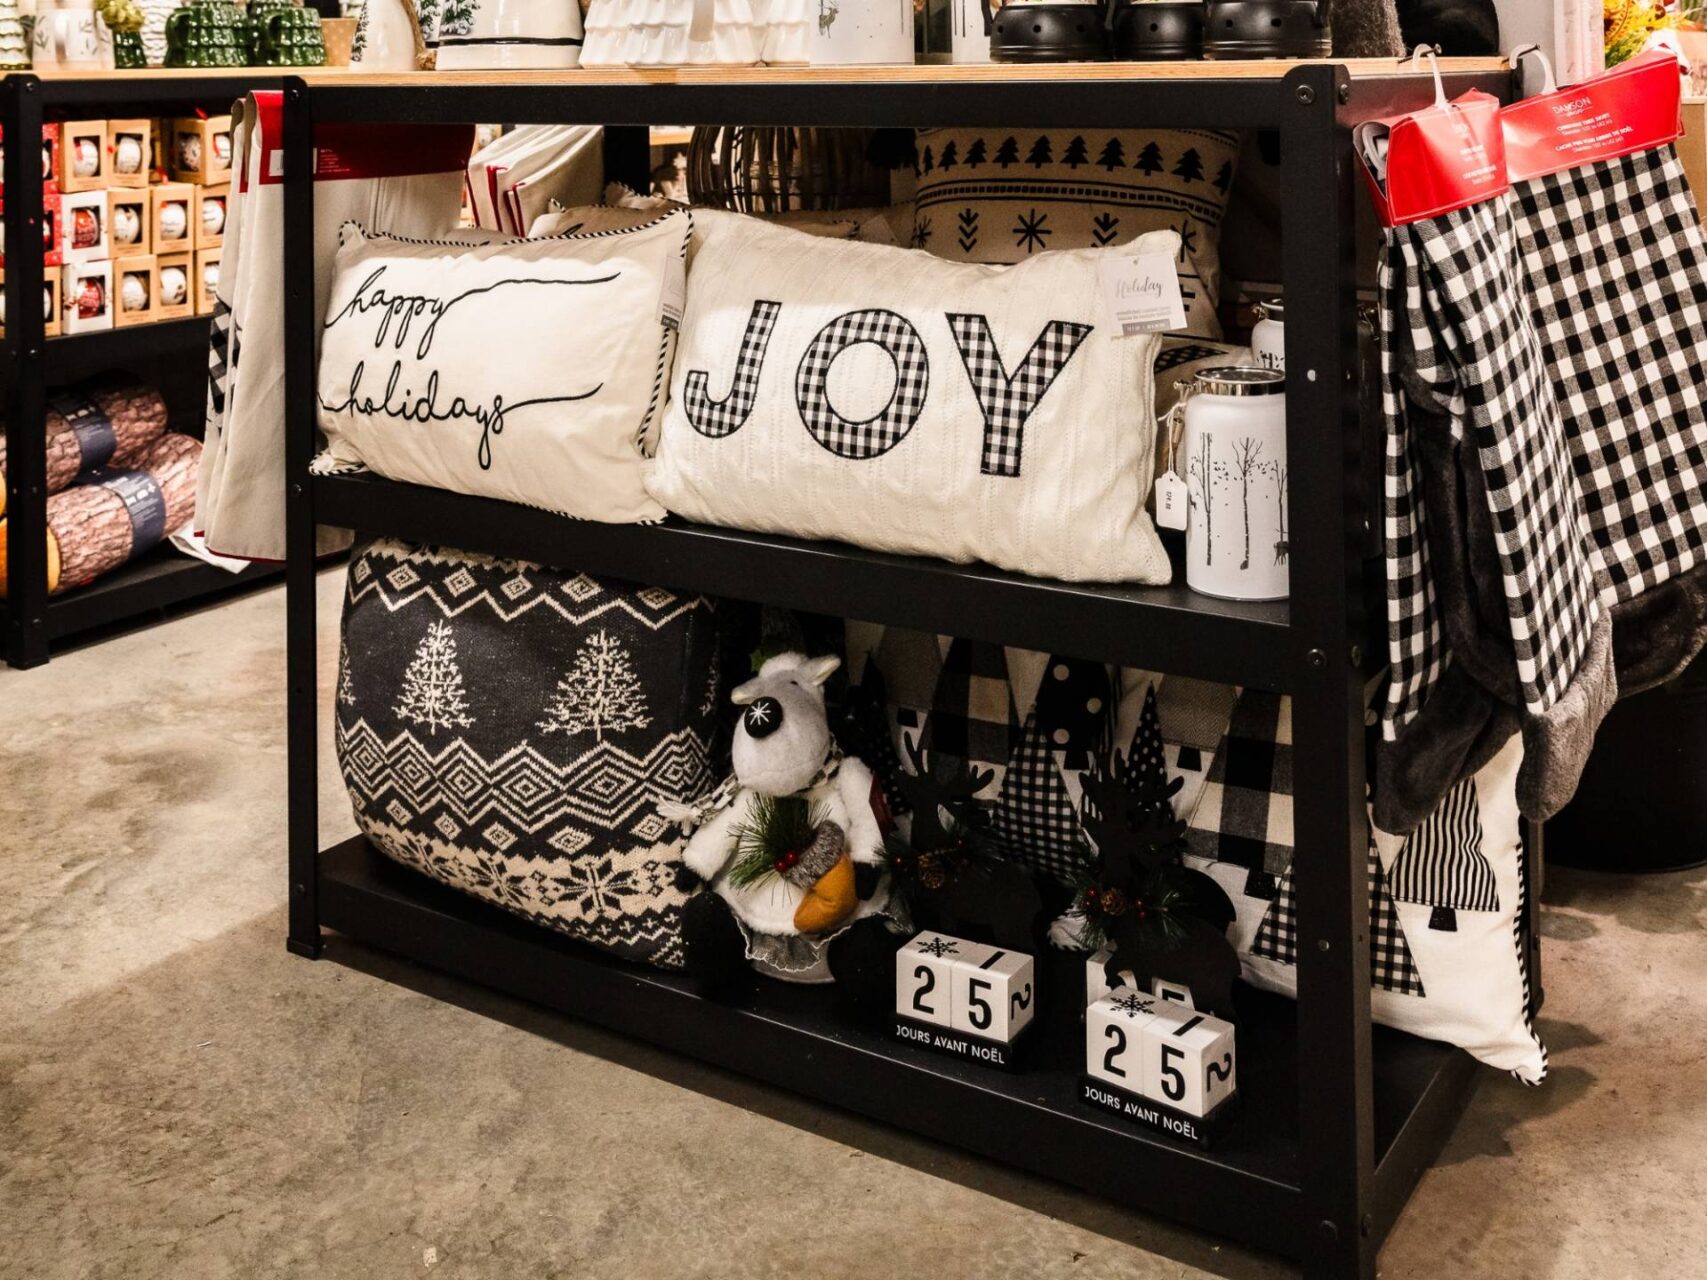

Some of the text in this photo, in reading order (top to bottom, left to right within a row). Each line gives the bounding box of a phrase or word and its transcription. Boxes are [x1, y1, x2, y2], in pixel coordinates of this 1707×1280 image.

[324, 265, 490, 359] happy
[1115, 276, 1162, 299] Holiday
[320, 361, 510, 470] holidays
[684, 299, 1095, 477] JOY
[896, 1024, 1005, 1065] JOURS AVANT NOËL
[1085, 1086, 1199, 1141] JOURS AVANT NOËL
